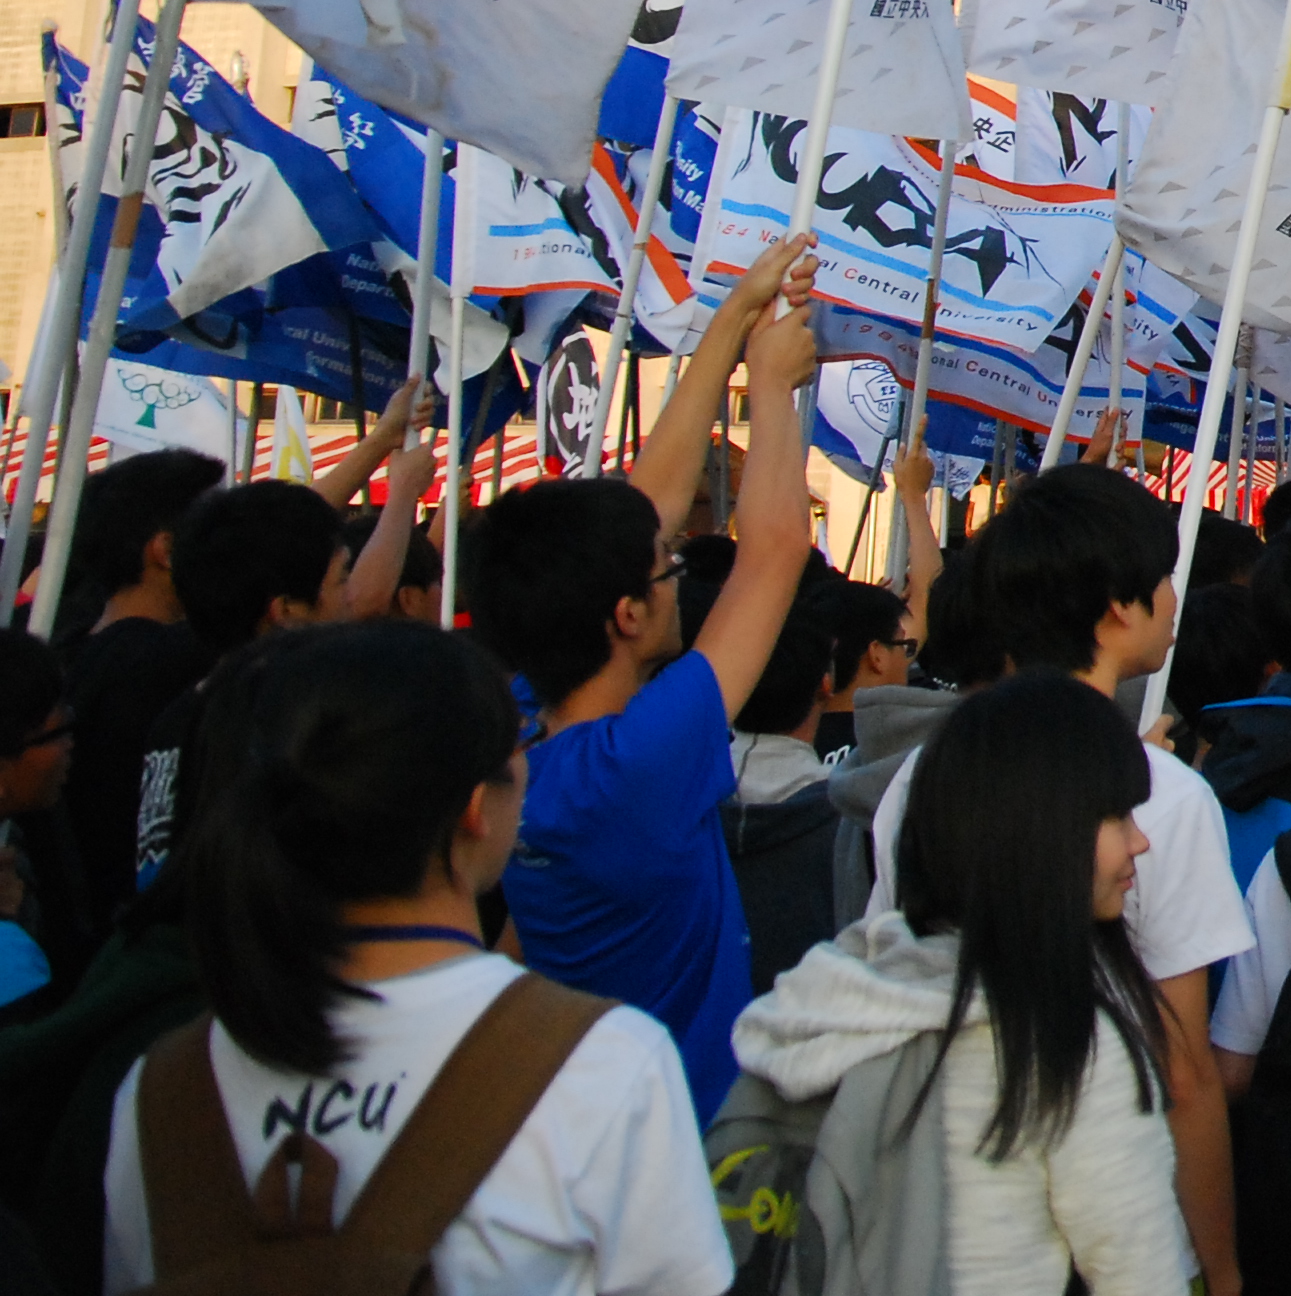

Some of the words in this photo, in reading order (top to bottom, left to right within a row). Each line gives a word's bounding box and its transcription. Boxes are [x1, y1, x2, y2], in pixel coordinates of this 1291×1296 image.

[843, 266, 919, 304] Central
[965, 360, 1032, 396] Central
[263, 1082, 392, 1139] NCU
